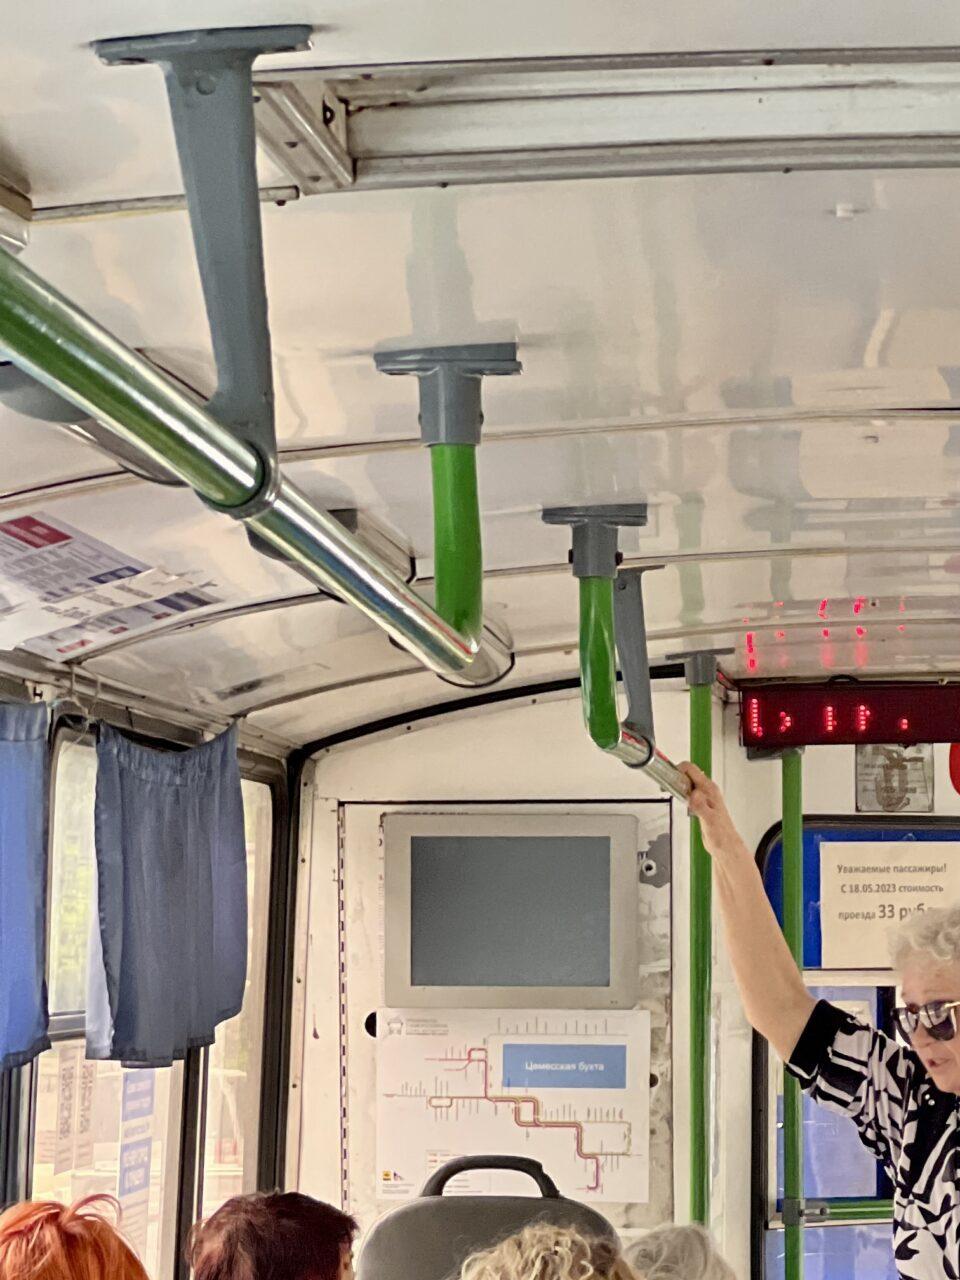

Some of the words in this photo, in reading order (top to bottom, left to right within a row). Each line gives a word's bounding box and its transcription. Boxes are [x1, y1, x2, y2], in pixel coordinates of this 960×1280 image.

[836, 864, 891, 874] Уважаемые
[893, 863, 947, 875] пассажиры!
[840, 884, 848, 893] С
[849, 883, 897, 893] 18.05.2023
[898, 885, 944, 893] стоимость
[838, 911, 876, 921] проезда
[878, 904, 895, 919] 33
[578, 1060, 605, 1073] бухта
